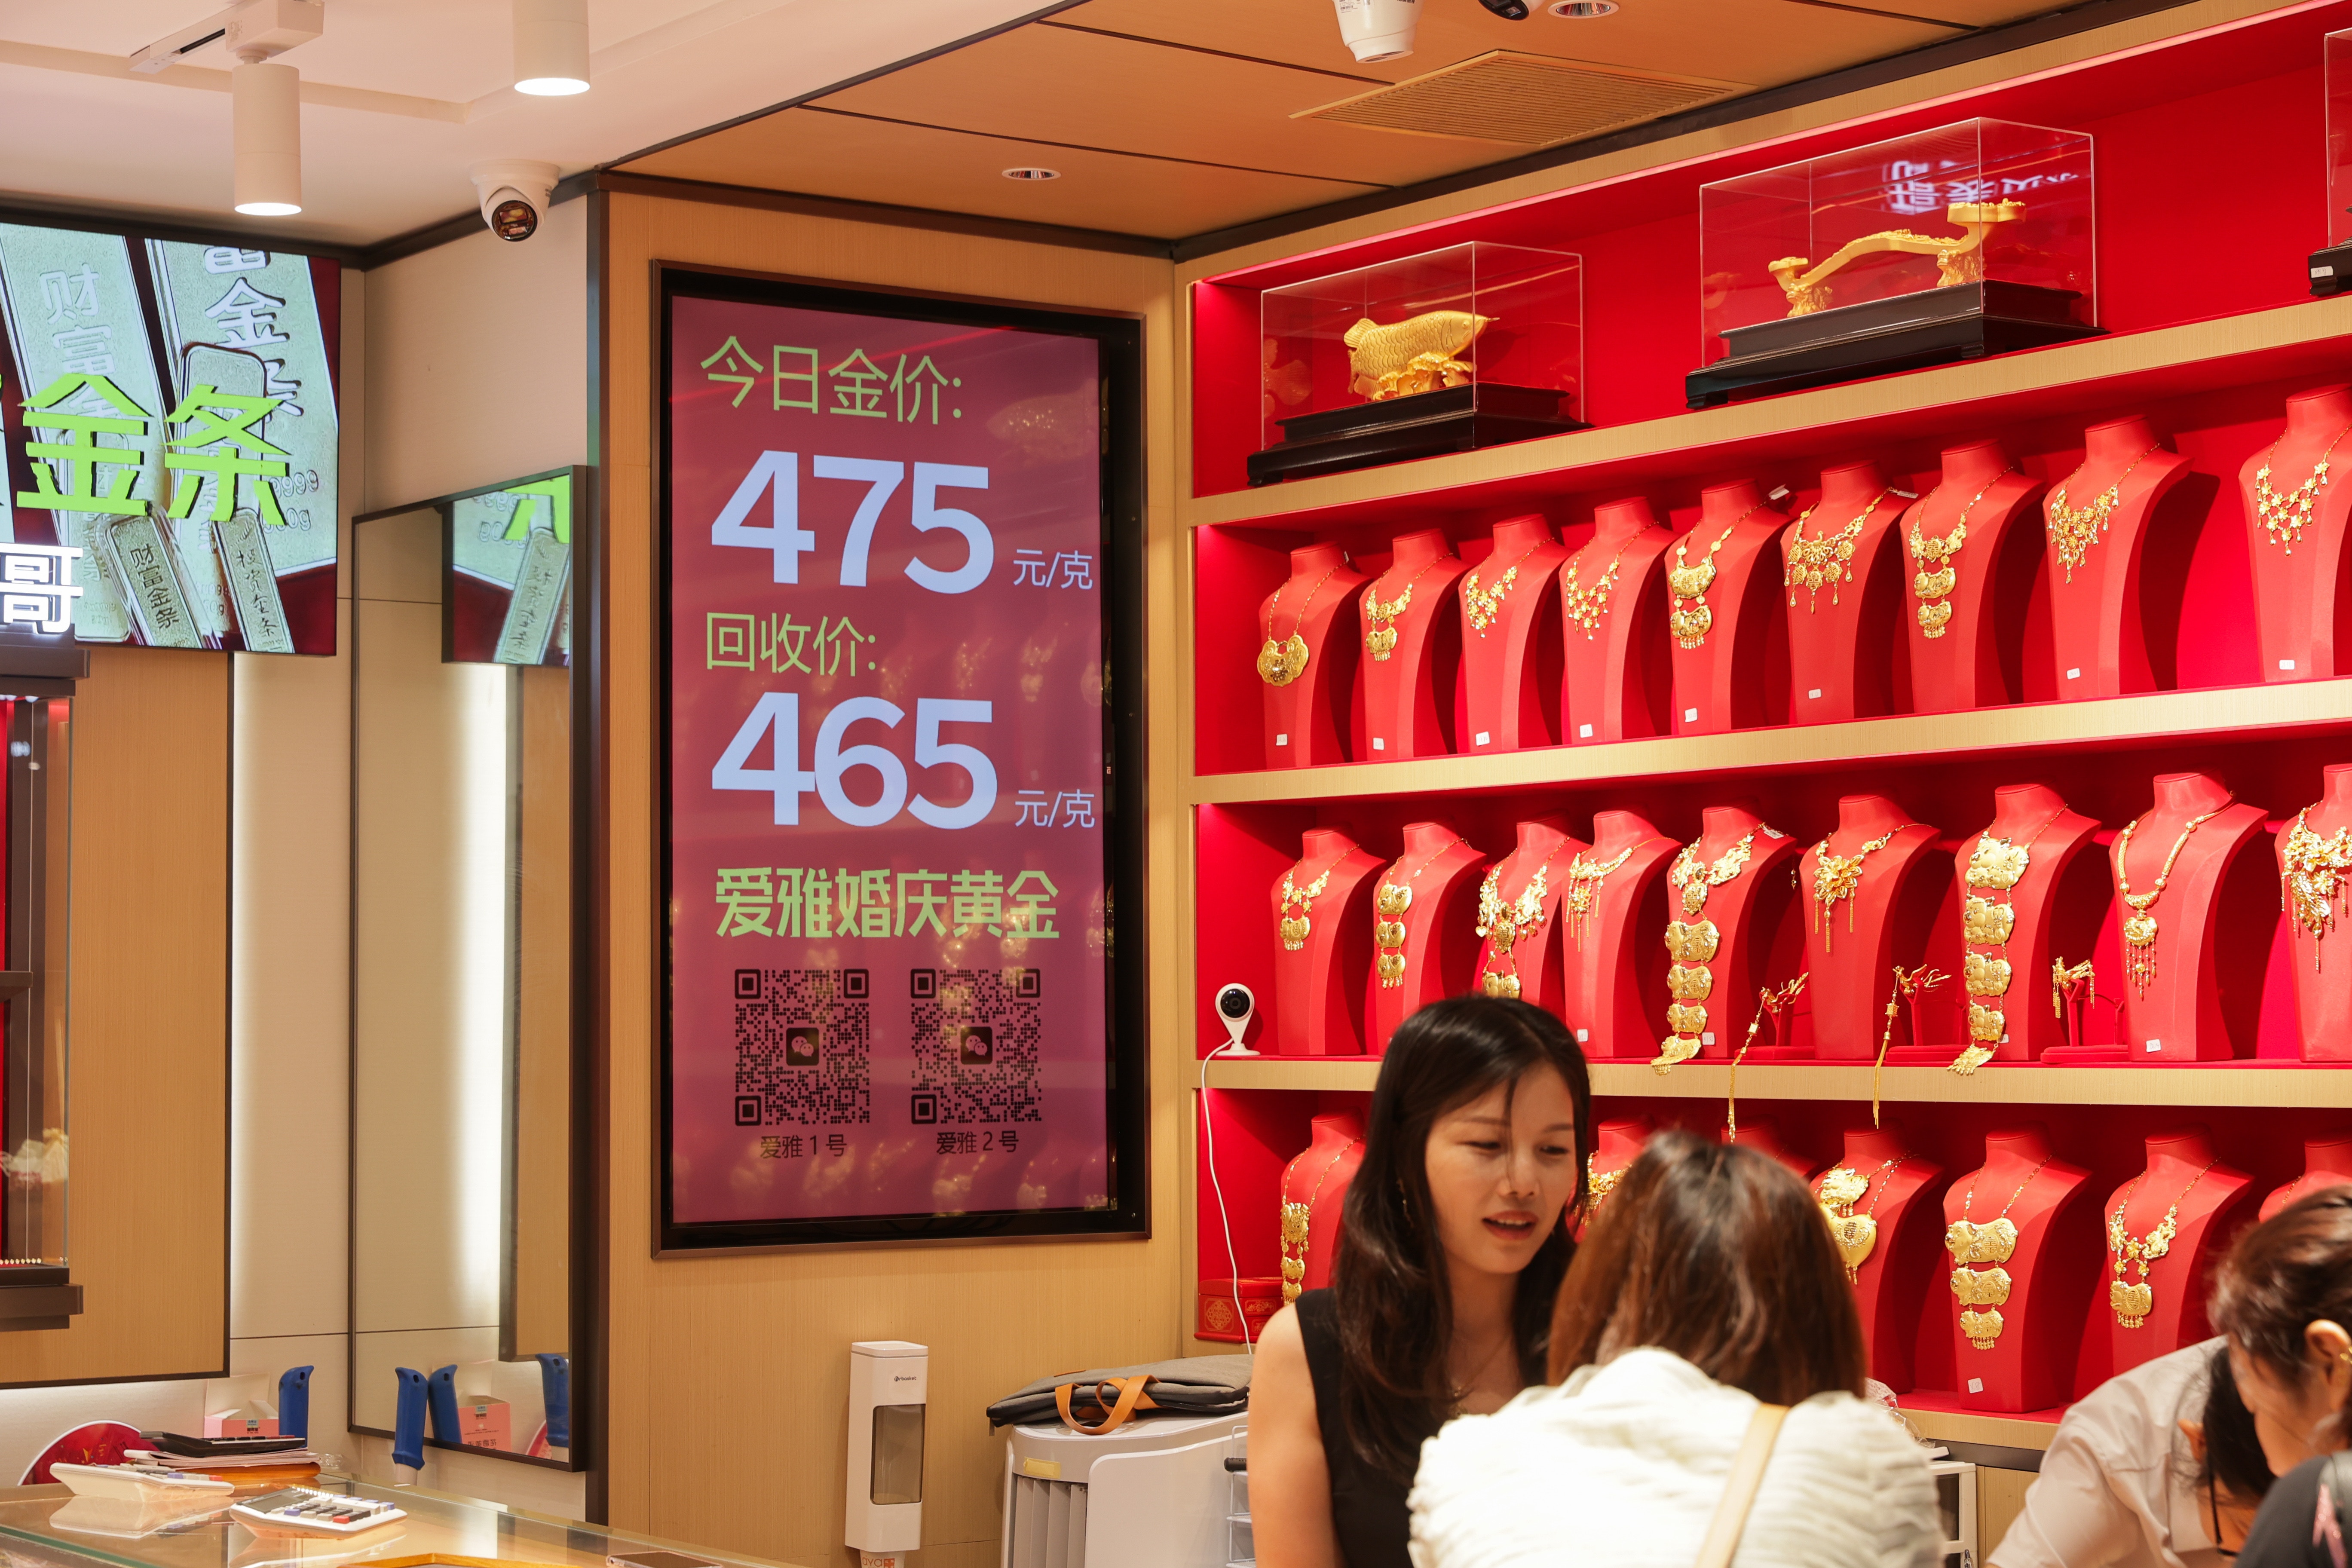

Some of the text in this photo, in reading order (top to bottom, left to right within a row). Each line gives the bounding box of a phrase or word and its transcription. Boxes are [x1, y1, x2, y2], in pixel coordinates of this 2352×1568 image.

[700, 335, 962, 425] 今日金价：
[0, 373, 294, 527] 金条
[711, 450, 1093, 594] 475 元/克
[130, 543, 180, 629] 财富金条
[236, 550, 278, 637] 投资金条
[706, 611, 877, 677] 回收价：
[712, 691, 1095, 830] 465 元/克
[715, 867, 1060, 939] 爱雅婚庆黄金
